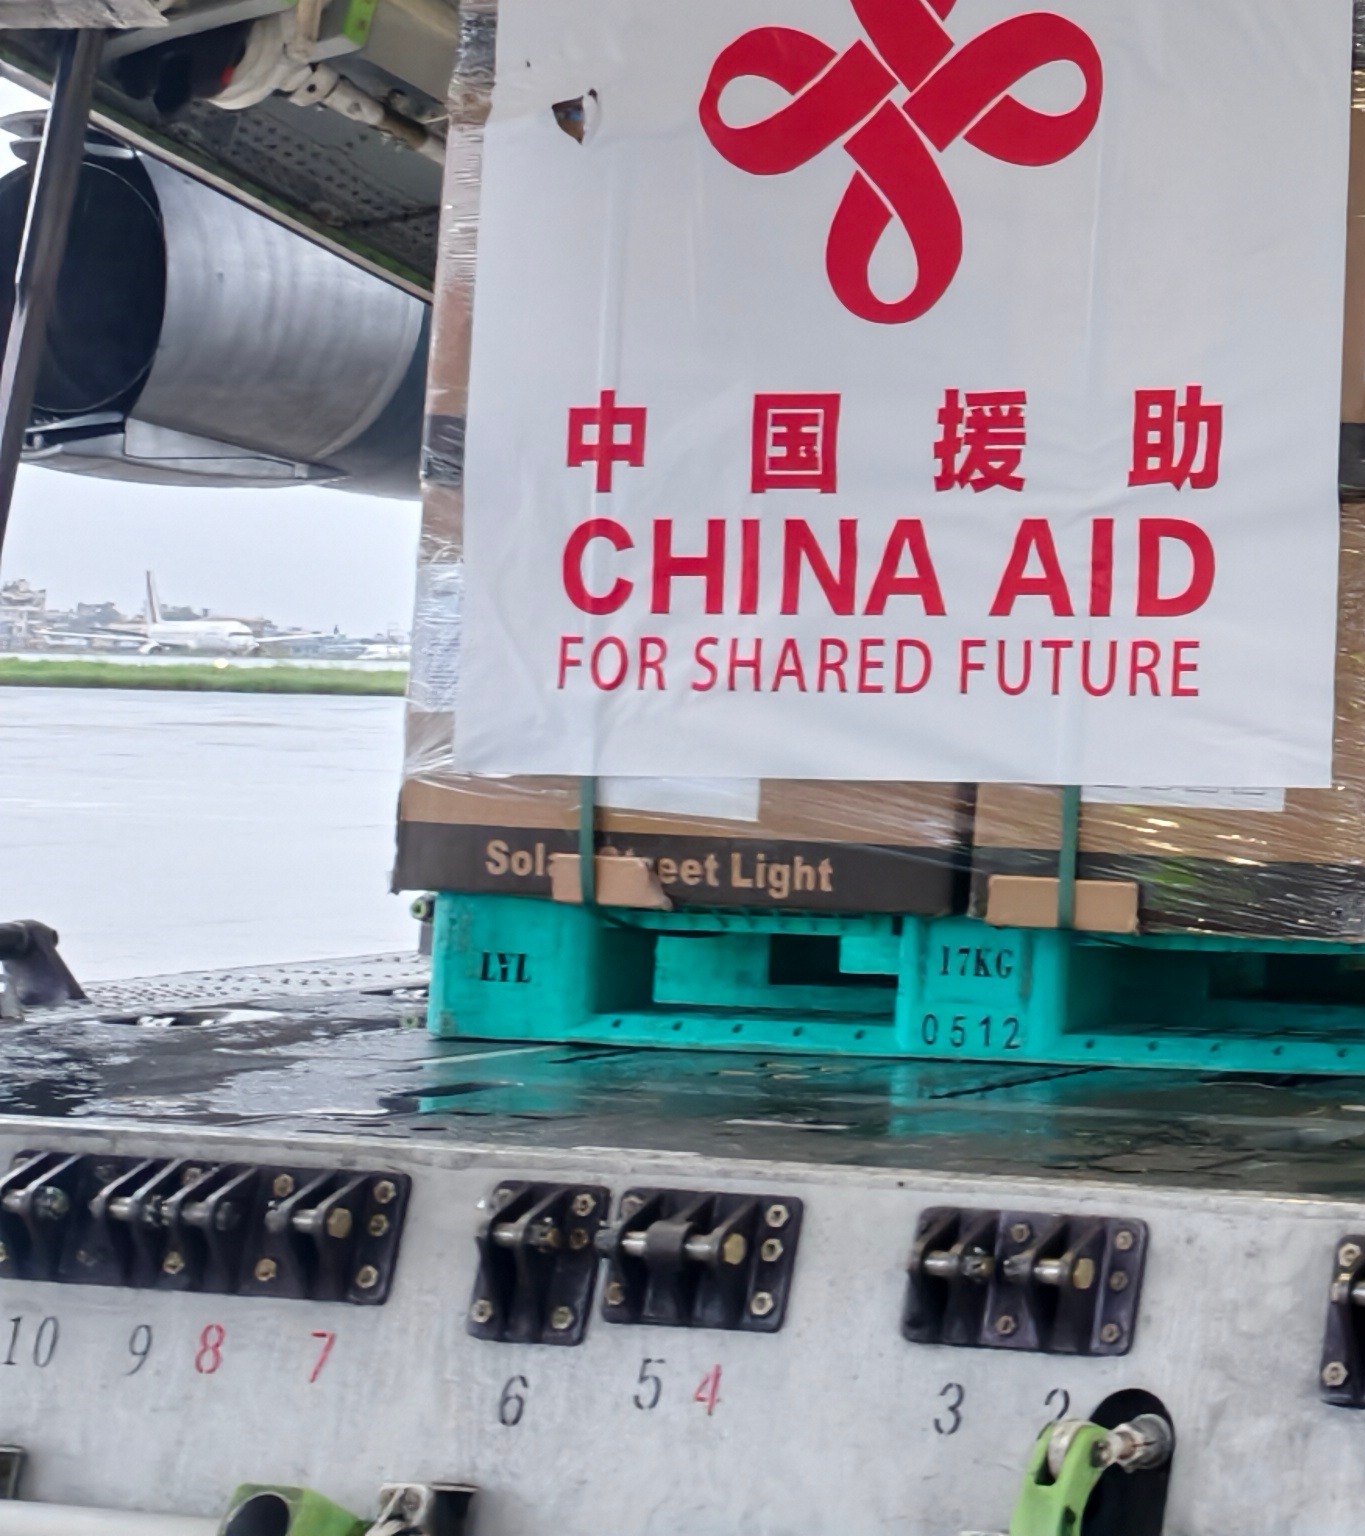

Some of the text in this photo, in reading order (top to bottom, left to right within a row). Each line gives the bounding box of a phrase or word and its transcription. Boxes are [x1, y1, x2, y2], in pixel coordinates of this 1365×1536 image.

[566, 384, 1224, 494] 中国援助
[562, 517, 1217, 618] CHINA AID
[557, 636, 1201, 697] FOR SHARED FUTURE
[731, 853, 834, 900] Light
[938, 944, 1015, 980] 17KG
[921, 1012, 1022, 1051] 0512
[2, 1315, 60, 1368] 10
[127, 1323, 153, 1377] 9
[195, 1323, 226, 1375] 8
[309, 1331, 337, 1383] 7
[497, 1374, 529, 1428] 6
[632, 1357, 666, 1411] 5
[693, 1364, 724, 1417] 4
[932, 1381, 966, 1436] 3
